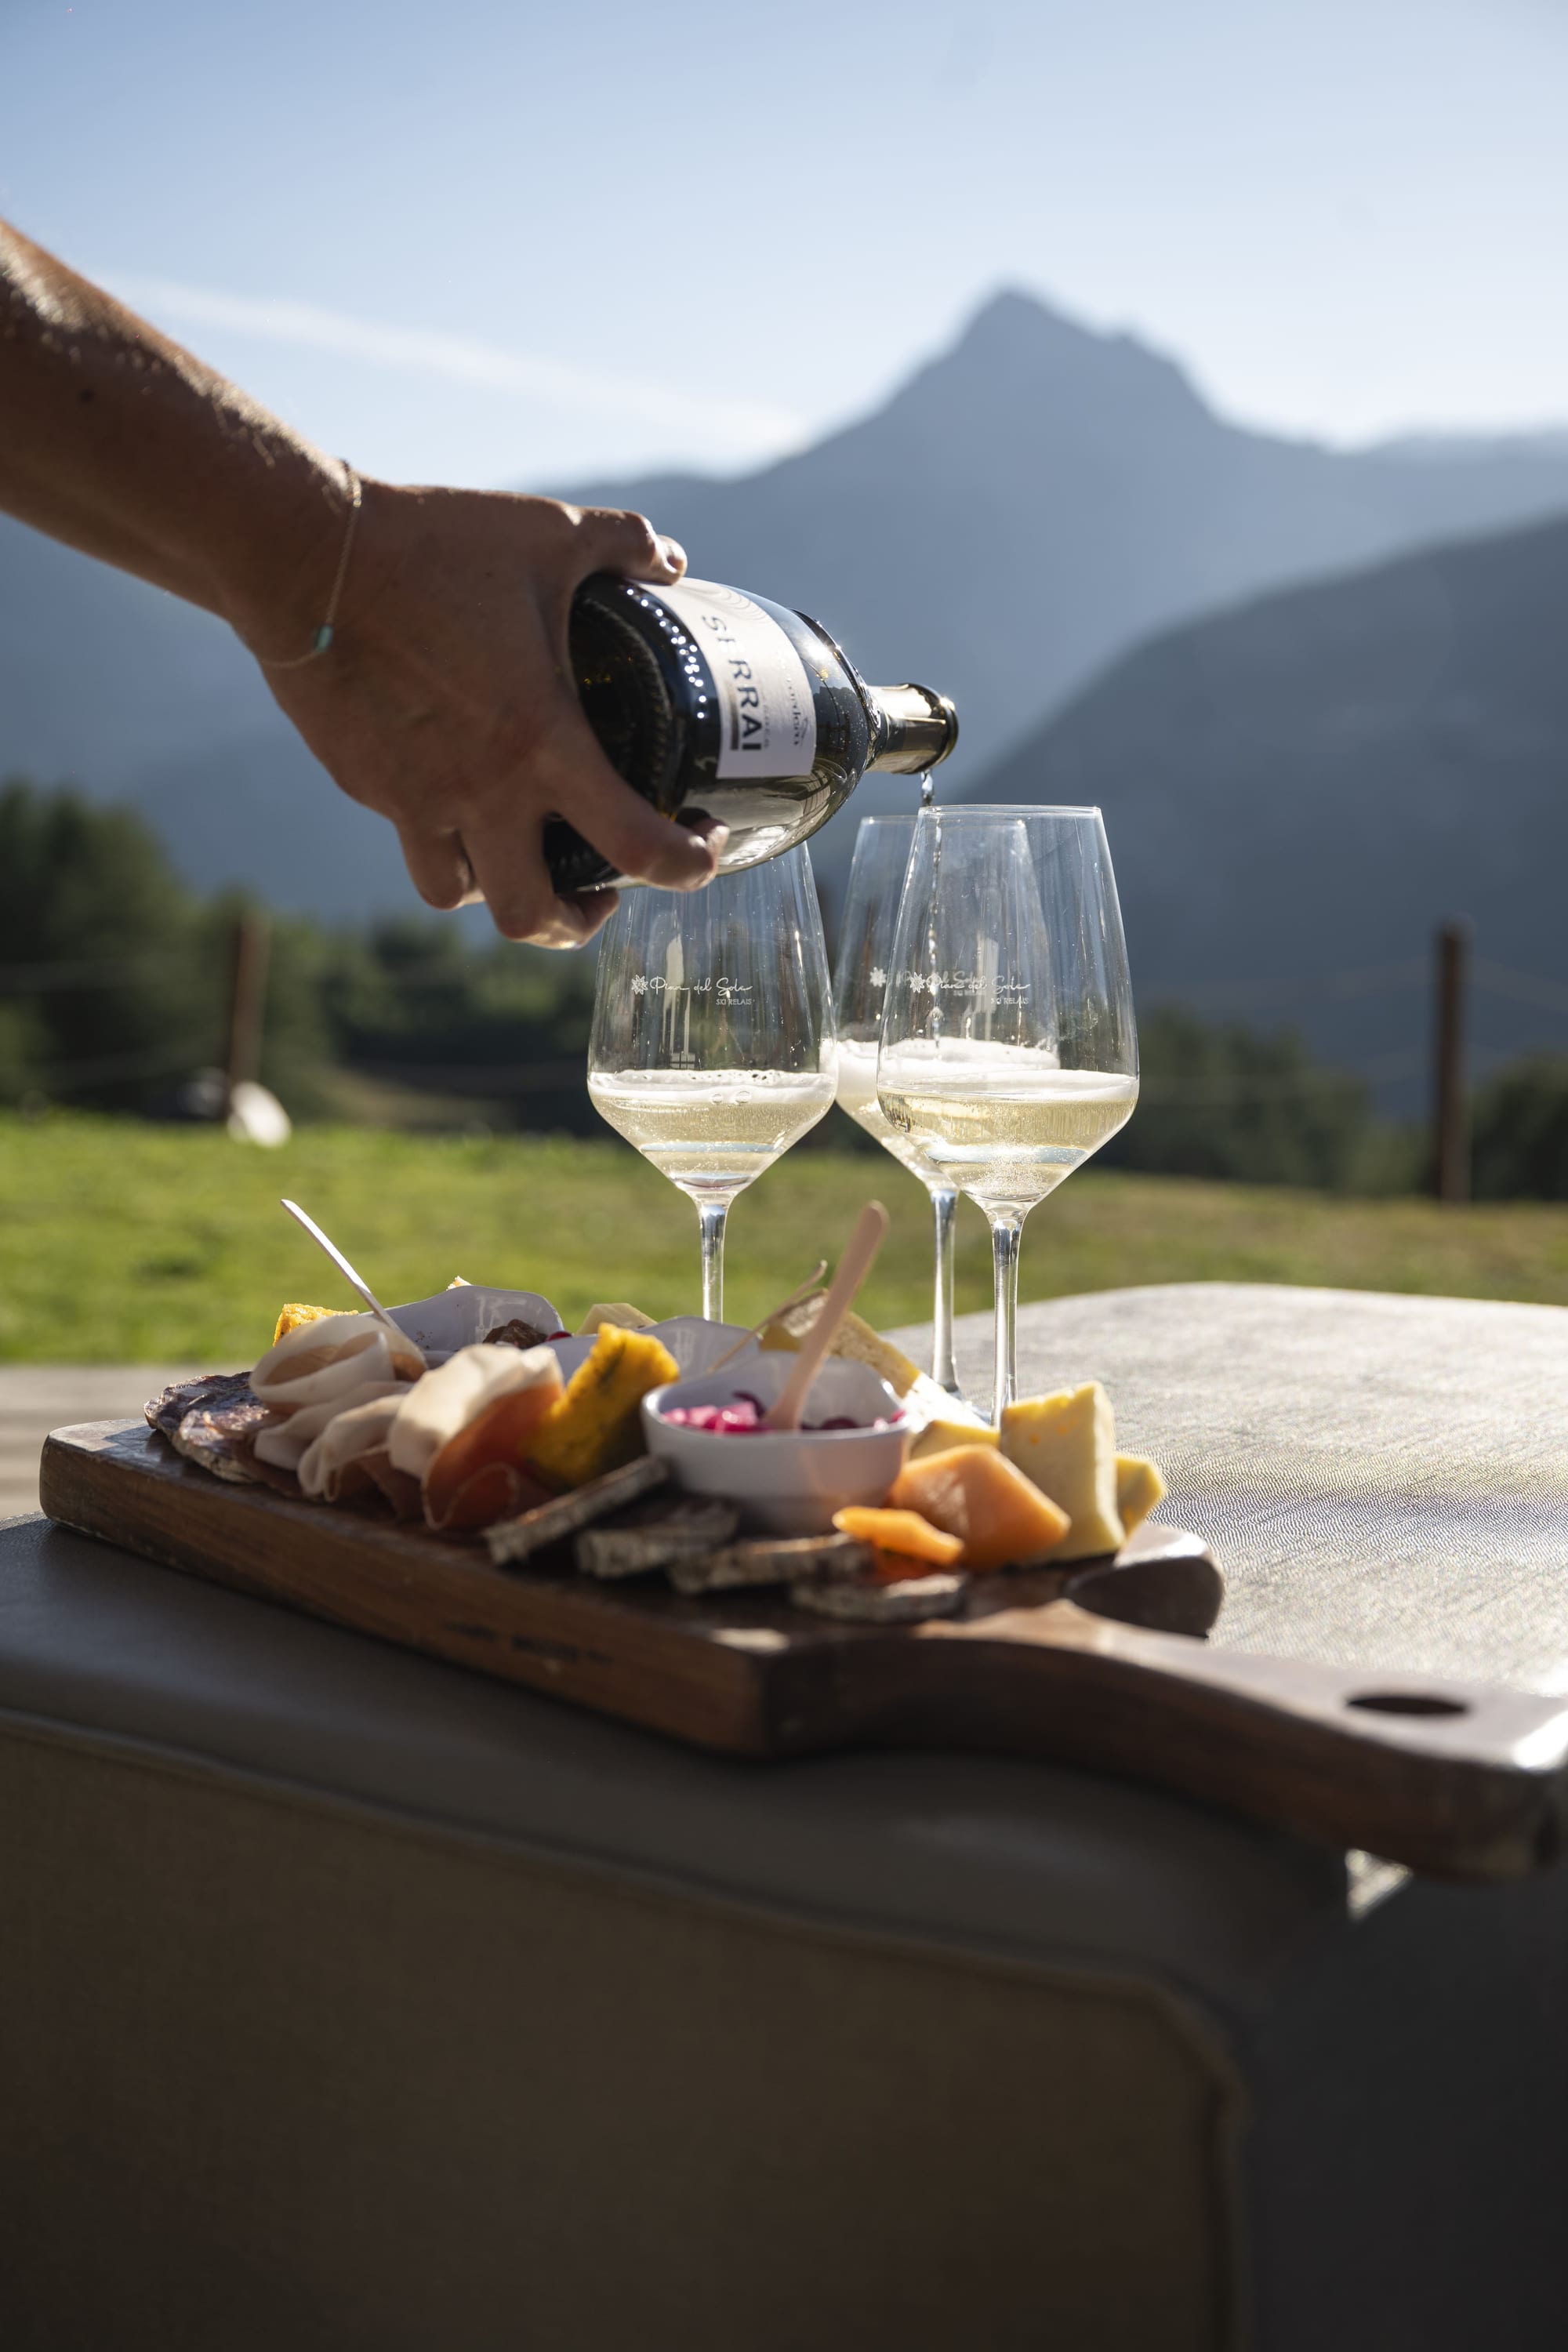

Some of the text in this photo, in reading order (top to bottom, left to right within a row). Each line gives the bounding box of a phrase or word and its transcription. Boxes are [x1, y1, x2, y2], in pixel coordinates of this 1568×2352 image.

[694, 978, 712, 994] del
[716, 977, 753, 996] Sole
[991, 975, 1030, 994] Sole
